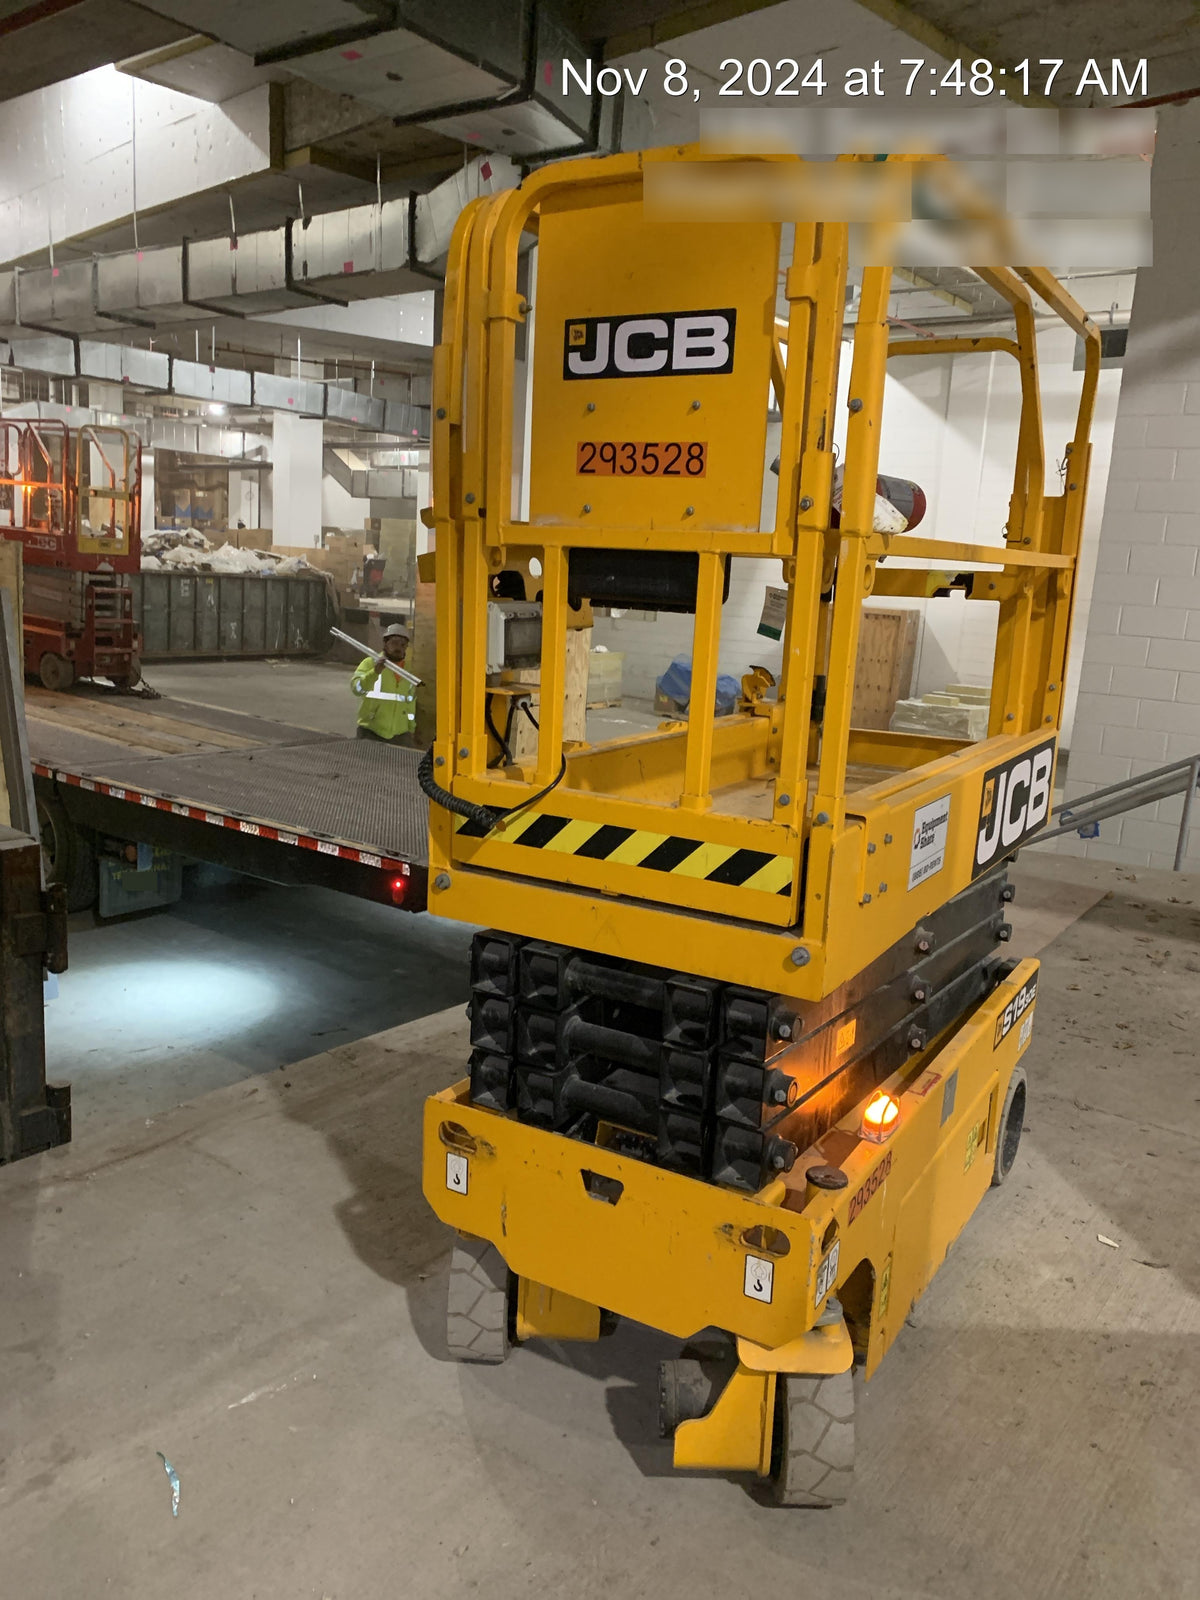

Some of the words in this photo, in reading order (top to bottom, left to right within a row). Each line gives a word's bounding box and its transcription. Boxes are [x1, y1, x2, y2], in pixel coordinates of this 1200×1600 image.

[568, 316, 730, 375] JCB
[578, 442, 705, 476] 293528
[976, 747, 1053, 866] JCB
